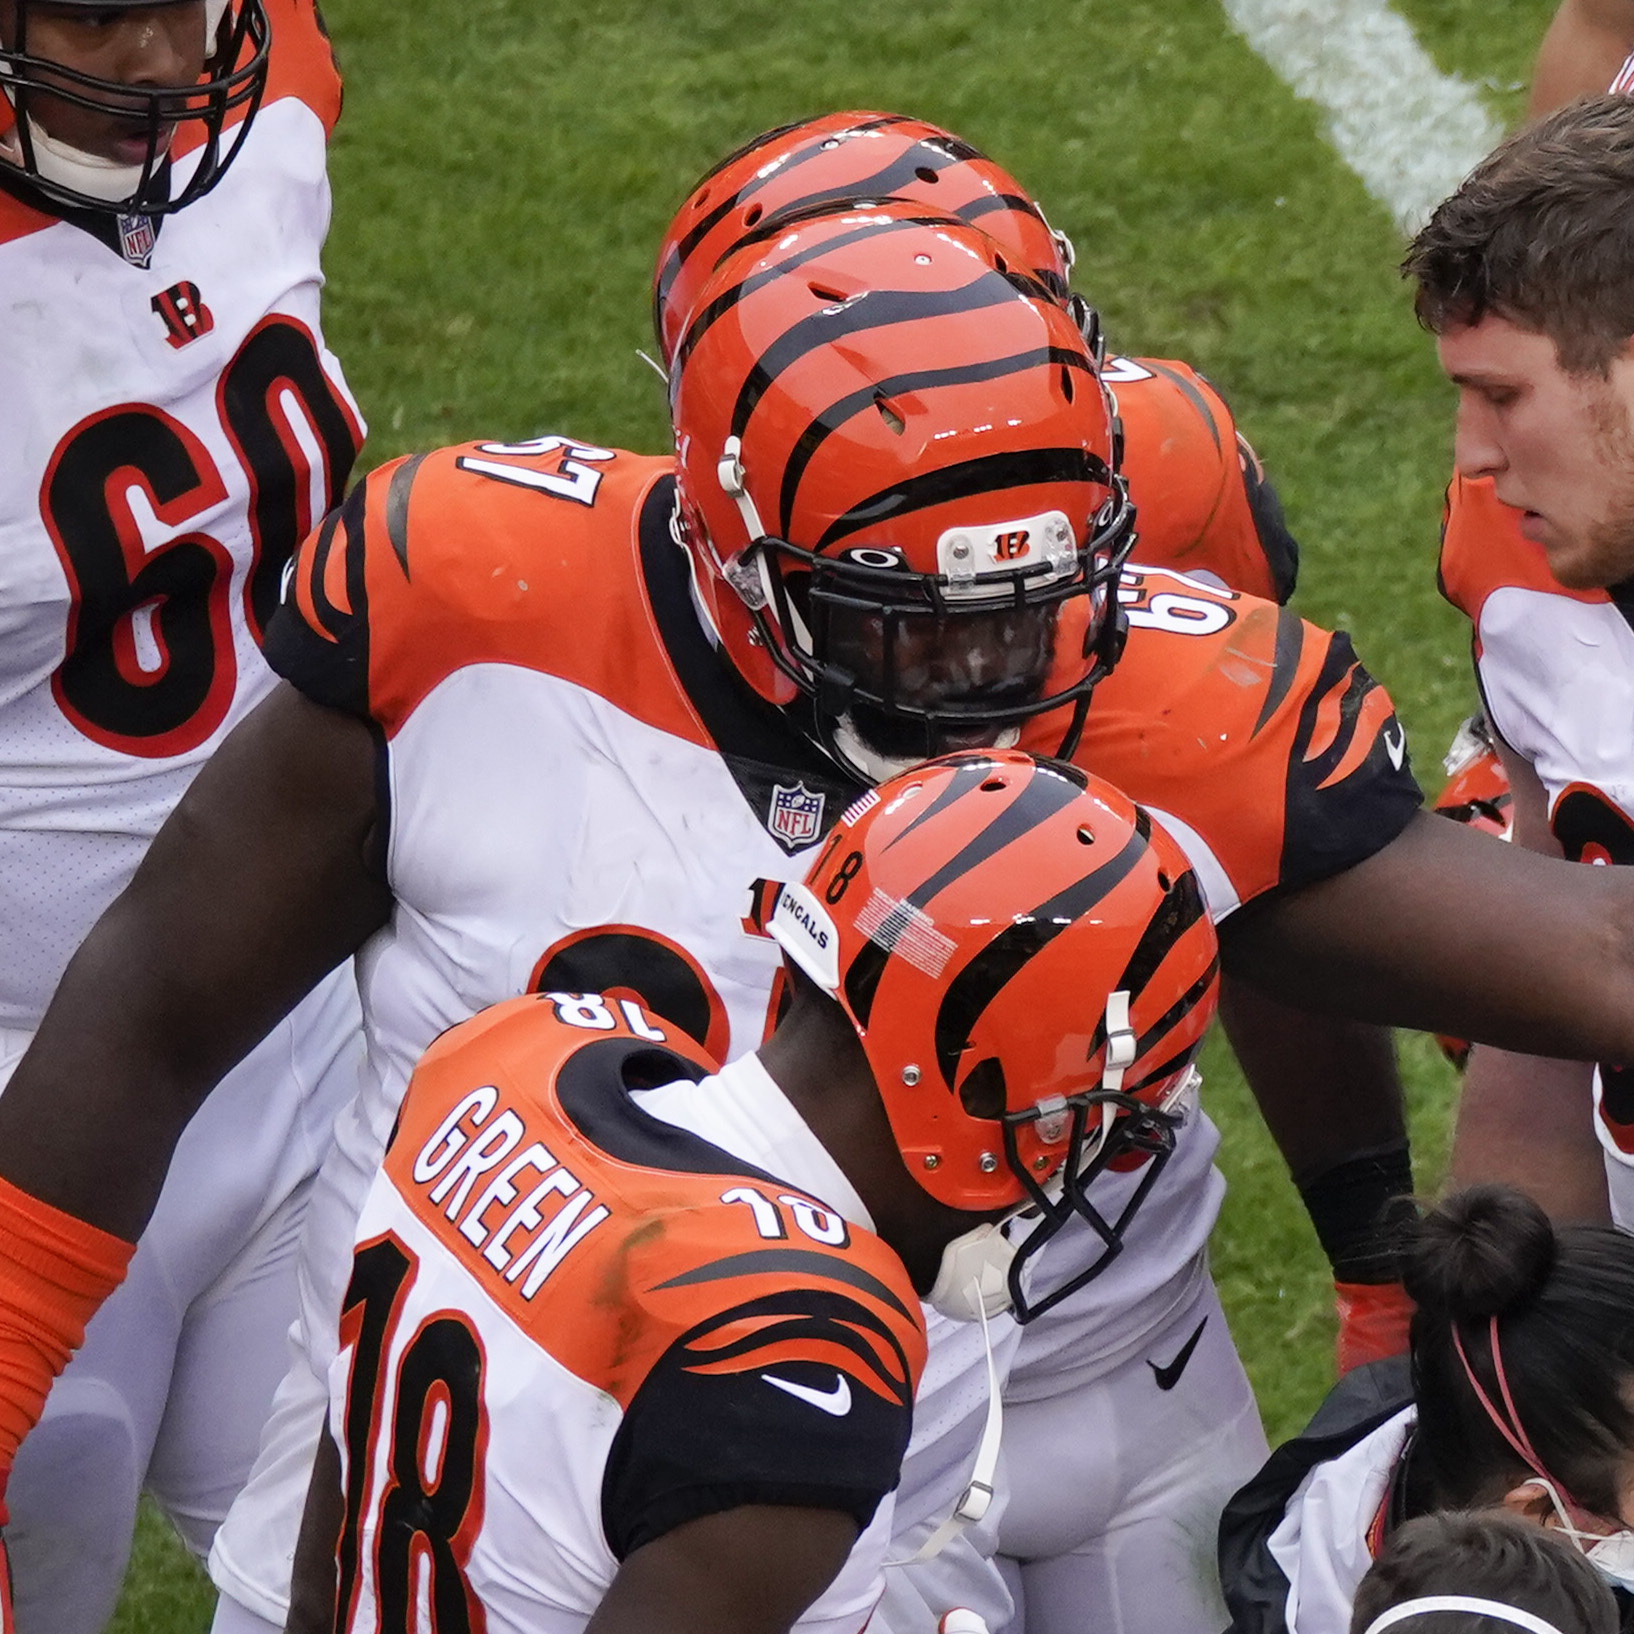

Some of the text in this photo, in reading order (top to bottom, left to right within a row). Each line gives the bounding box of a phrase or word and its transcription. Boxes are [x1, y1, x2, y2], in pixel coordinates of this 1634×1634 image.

[38, 313, 367, 759] 60
[776, 809, 812, 836] NFL
[807, 833, 864, 906] 18
[781, 893, 830, 950] ENGALS
[411, 1086, 611, 1303] GREEN
